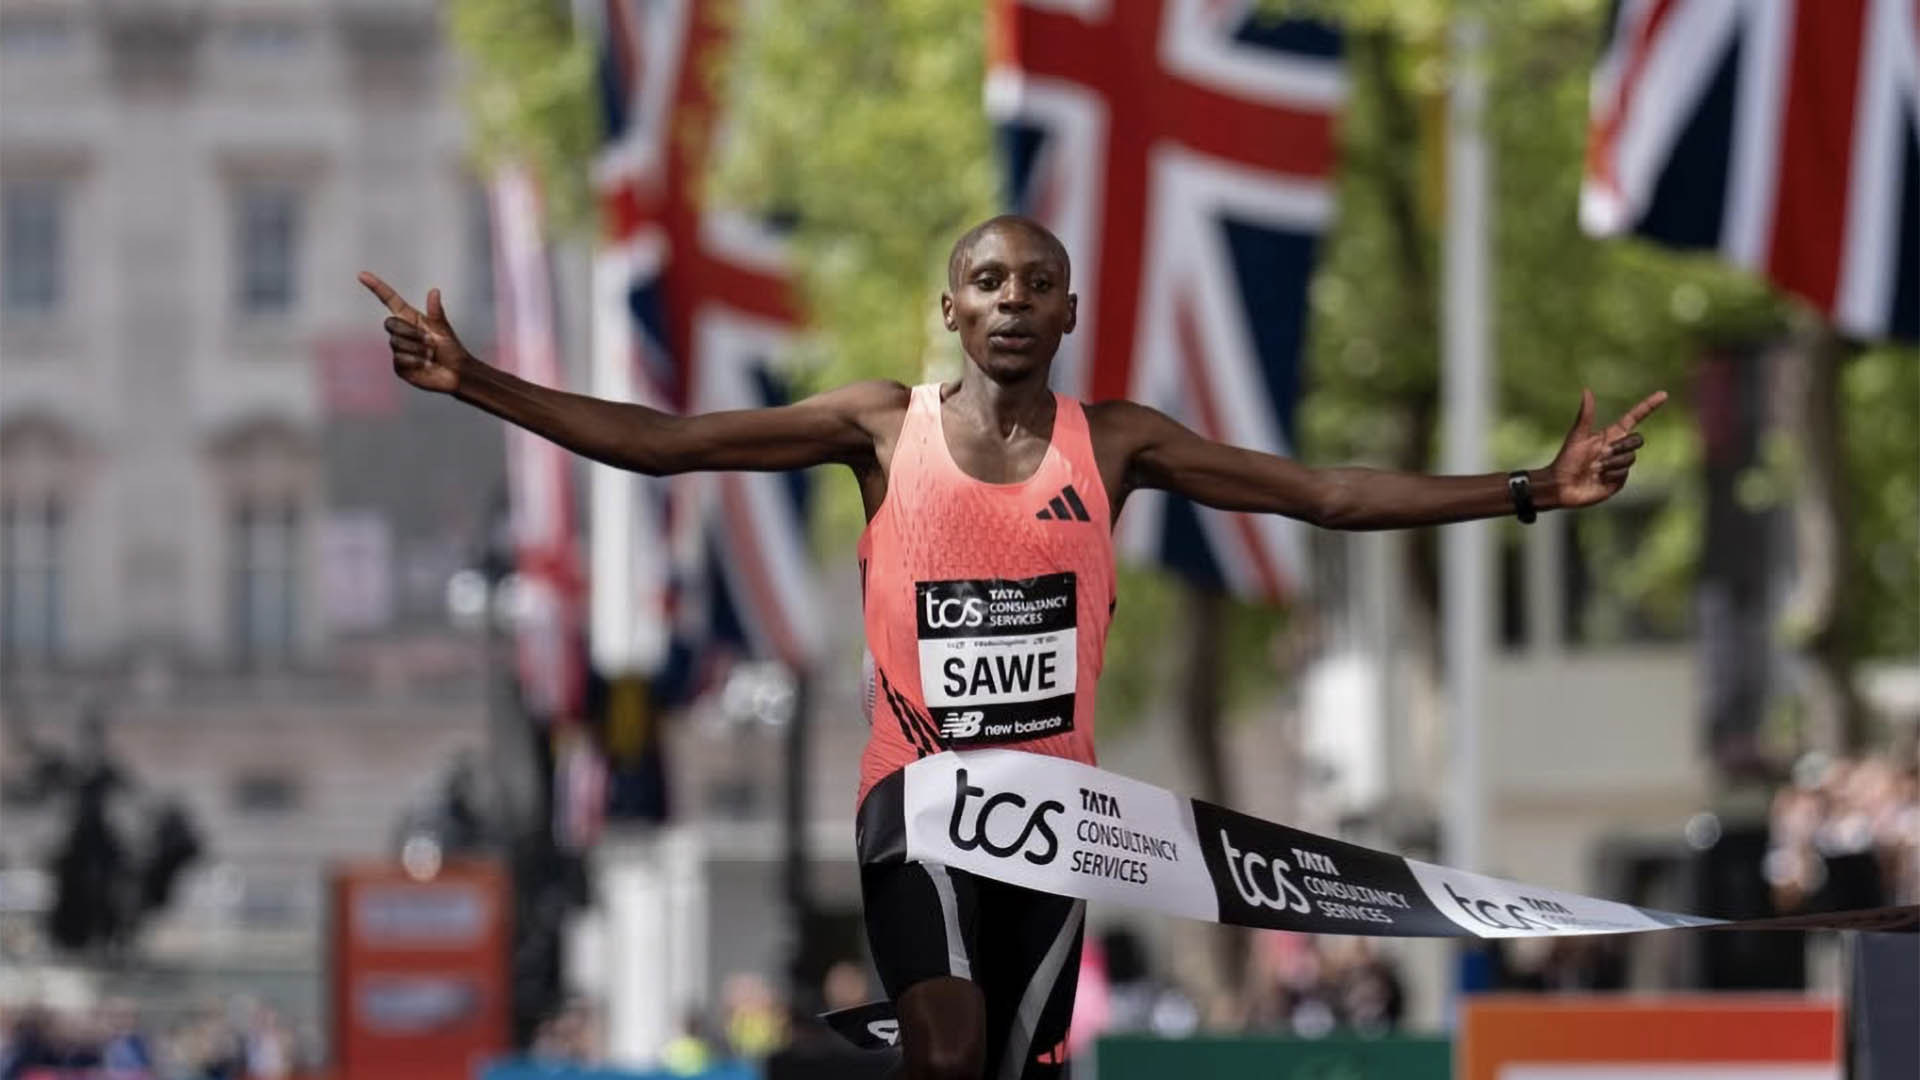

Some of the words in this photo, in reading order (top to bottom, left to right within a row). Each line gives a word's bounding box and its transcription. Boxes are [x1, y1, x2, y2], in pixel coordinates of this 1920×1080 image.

[926, 590, 984, 629] tcs
[989, 589, 1024, 600] TATA
[989, 596, 1068, 613] CONSULTANCY
[990, 613, 1043, 627] SERVICES
[943, 651, 1057, 698] SAWE
[985, 723, 1012, 736] new
[1014, 716, 1063, 734] balance
[949, 768, 1065, 866] tcs
[1079, 788, 1121, 818] TATA
[1076, 819, 1179, 861] CONSULTANCY
[1071, 850, 1149, 884] SERVICES
[1220, 829, 1311, 914] tcs
[1291, 848, 1341, 876] TATA
[1303, 875, 1411, 909] CONSULTANCY
[1442, 882, 1558, 930] tcs
[1518, 896, 1574, 915] TATA
[1316, 901, 1395, 924] SERVICES
